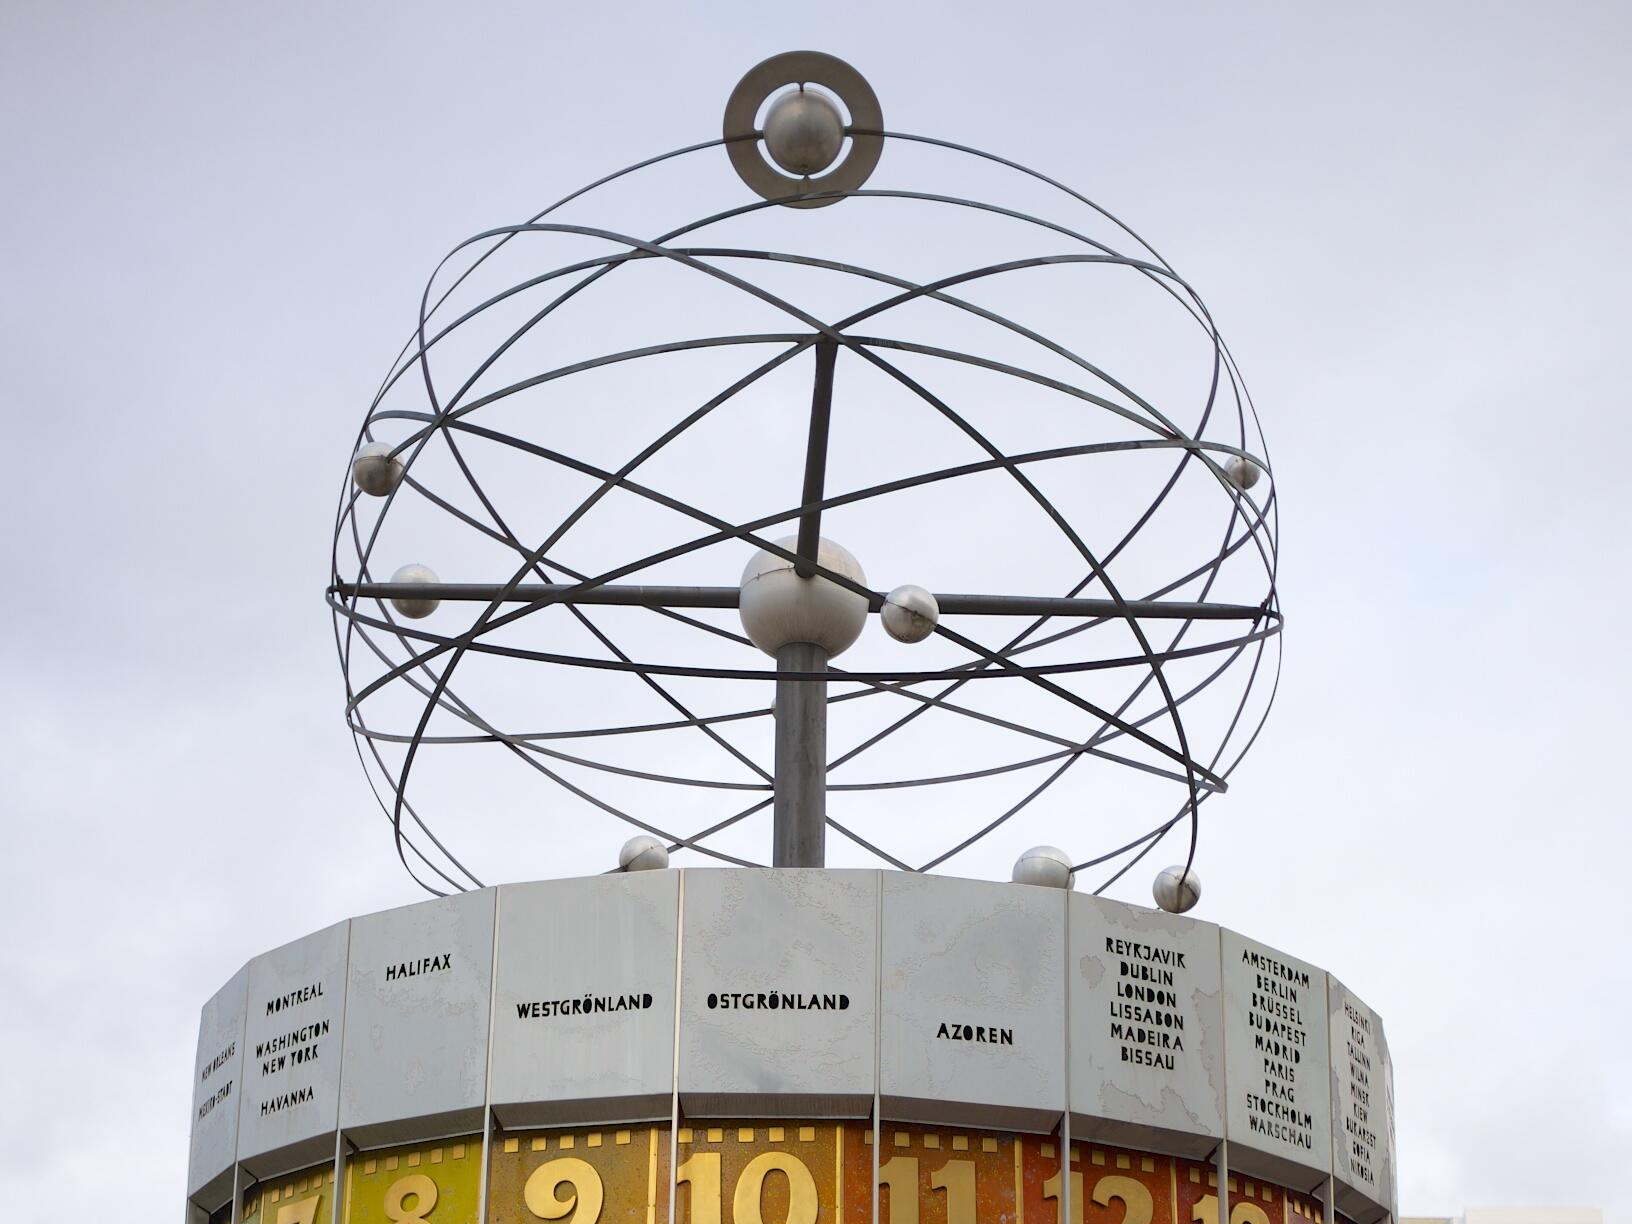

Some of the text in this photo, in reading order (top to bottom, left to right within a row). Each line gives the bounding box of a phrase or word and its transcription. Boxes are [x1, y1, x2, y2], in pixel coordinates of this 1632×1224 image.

[386, 953, 451, 981] HALIFAX
[1106, 937, 1186, 969] REYKJAVIK
[1120, 961, 1173, 986] DUBLIN
[1242, 949, 1309, 989] AMSTERDAM
[266, 982, 324, 1016] MONTREAL
[707, 990, 850, 1010] OSTGRÖNLAND
[1117, 981, 1176, 1008] LONDON
[1256, 974, 1297, 1003] BERLIN
[516, 993, 653, 1019] WESTGRÖNLAND
[1110, 1001, 1184, 1031] LISSABON
[1252, 992, 1302, 1025] BRÜSSEL
[1345, 1002, 1371, 1035] HELSINKI
[256, 1019, 330, 1059] WASHINGTON
[936, 1023, 1013, 1046] AZOREN
[1110, 1022, 1184, 1052] MADEIRA
[1249, 1011, 1306, 1047] BUDAPEST
[1351, 1027, 1365, 1045] RIGA
[262, 1044, 318, 1077] NEW YORK
[1121, 1046, 1174, 1071] BISSAU
[1255, 1035, 1300, 1064] MADRID
[1347, 1041, 1371, 1071] TALLINN
[1264, 1058, 1295, 1083] PARIS
[261, 1086, 314, 1117] HAVANNA
[1265, 1079, 1294, 1103] PRAG
[1247, 1094, 1312, 1130] STOCKHOLM
[1353, 1103, 1368, 1124] KIEW
[1249, 1115, 1312, 1149] WARSCHAU
[1350, 1158, 1374, 1186] NIKOSIA
